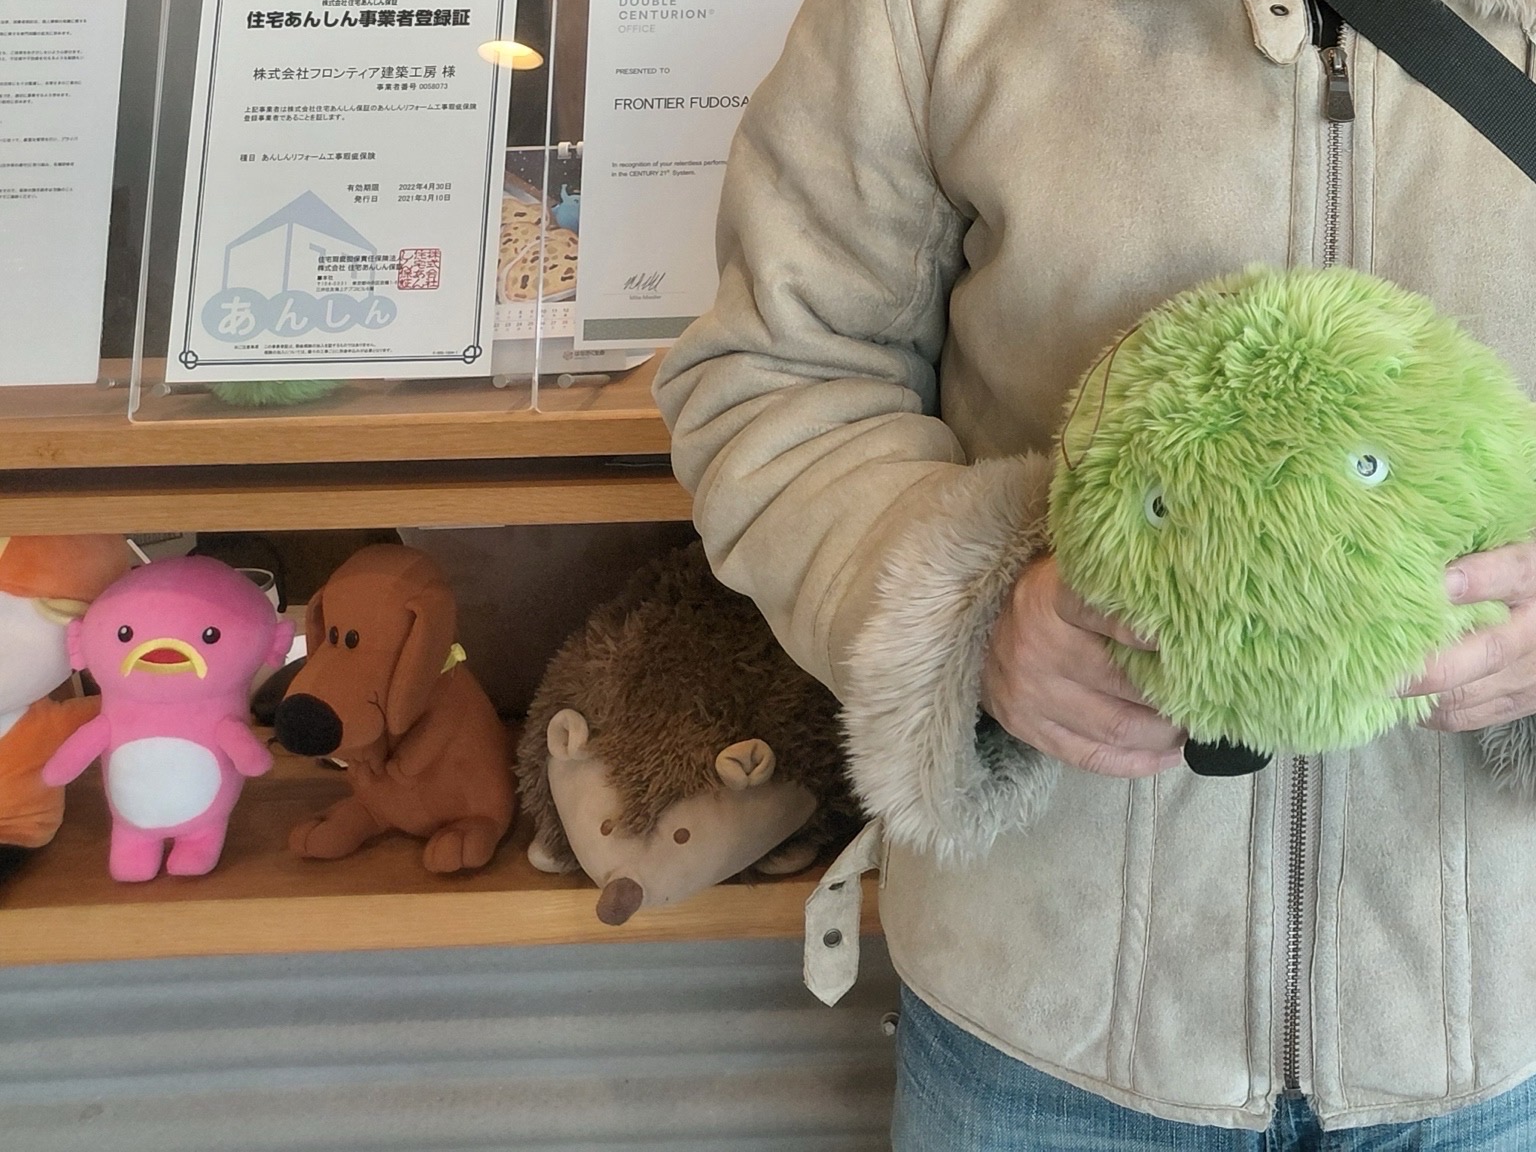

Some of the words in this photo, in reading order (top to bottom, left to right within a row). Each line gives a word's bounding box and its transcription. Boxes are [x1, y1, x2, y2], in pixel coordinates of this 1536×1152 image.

[247, 9, 471, 29] 住宅あんしん事業者登録証
[618, 25, 655, 33] OFFICE
[614, 98, 684, 110] FRONTIER
[704, 159, 728, 167] perform
[218, 297, 390, 335] あんしん
